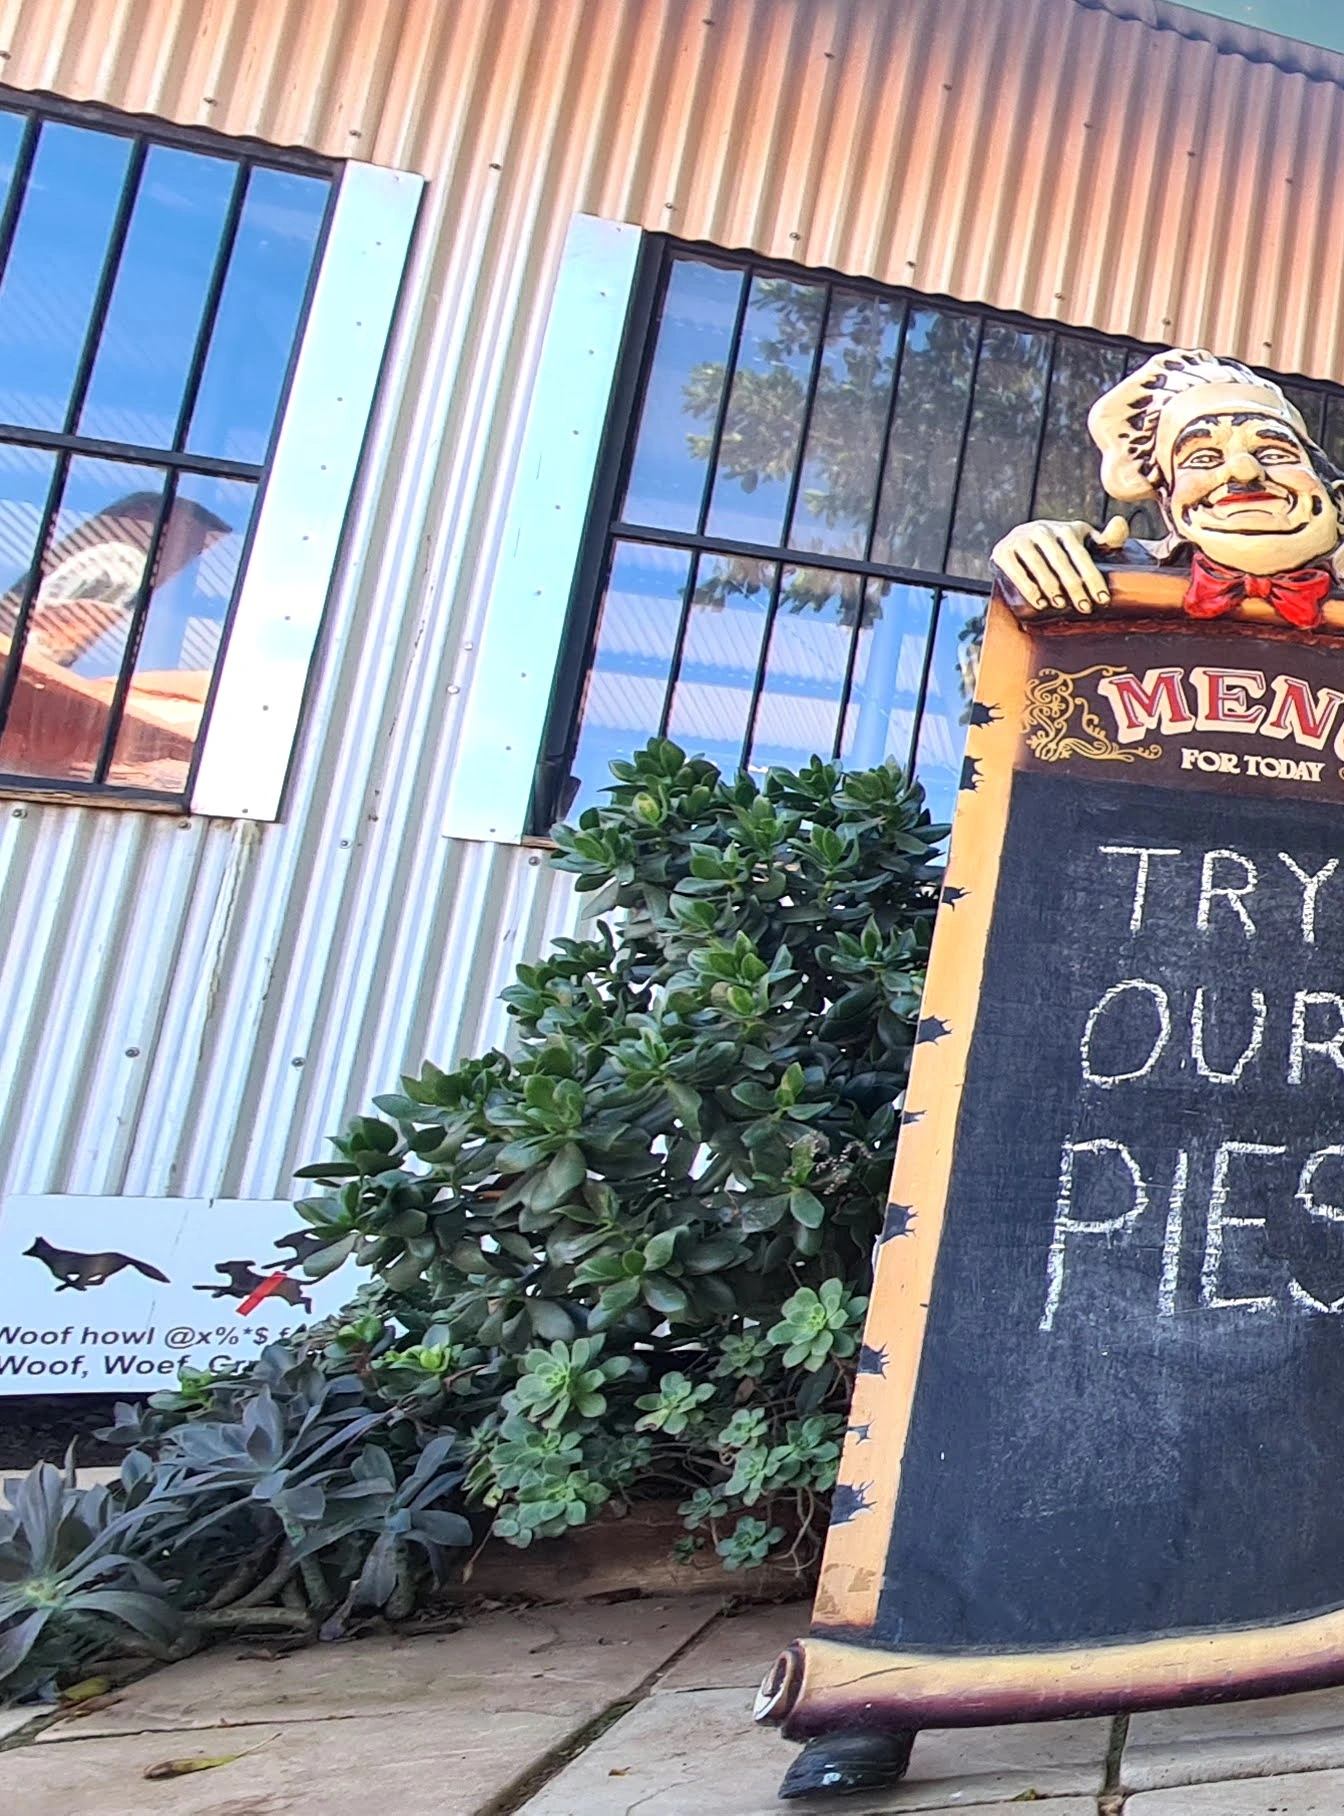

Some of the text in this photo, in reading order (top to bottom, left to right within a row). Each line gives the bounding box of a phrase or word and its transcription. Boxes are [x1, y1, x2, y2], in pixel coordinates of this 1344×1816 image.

[1180, 748, 1326, 782] FOR TODAY
[1099, 845, 1340, 943] TRY
[0, 1326, 74, 1345] Woof
[80, 1326, 155, 1345] howl
[0, 1355, 88, 1379] Woof,
